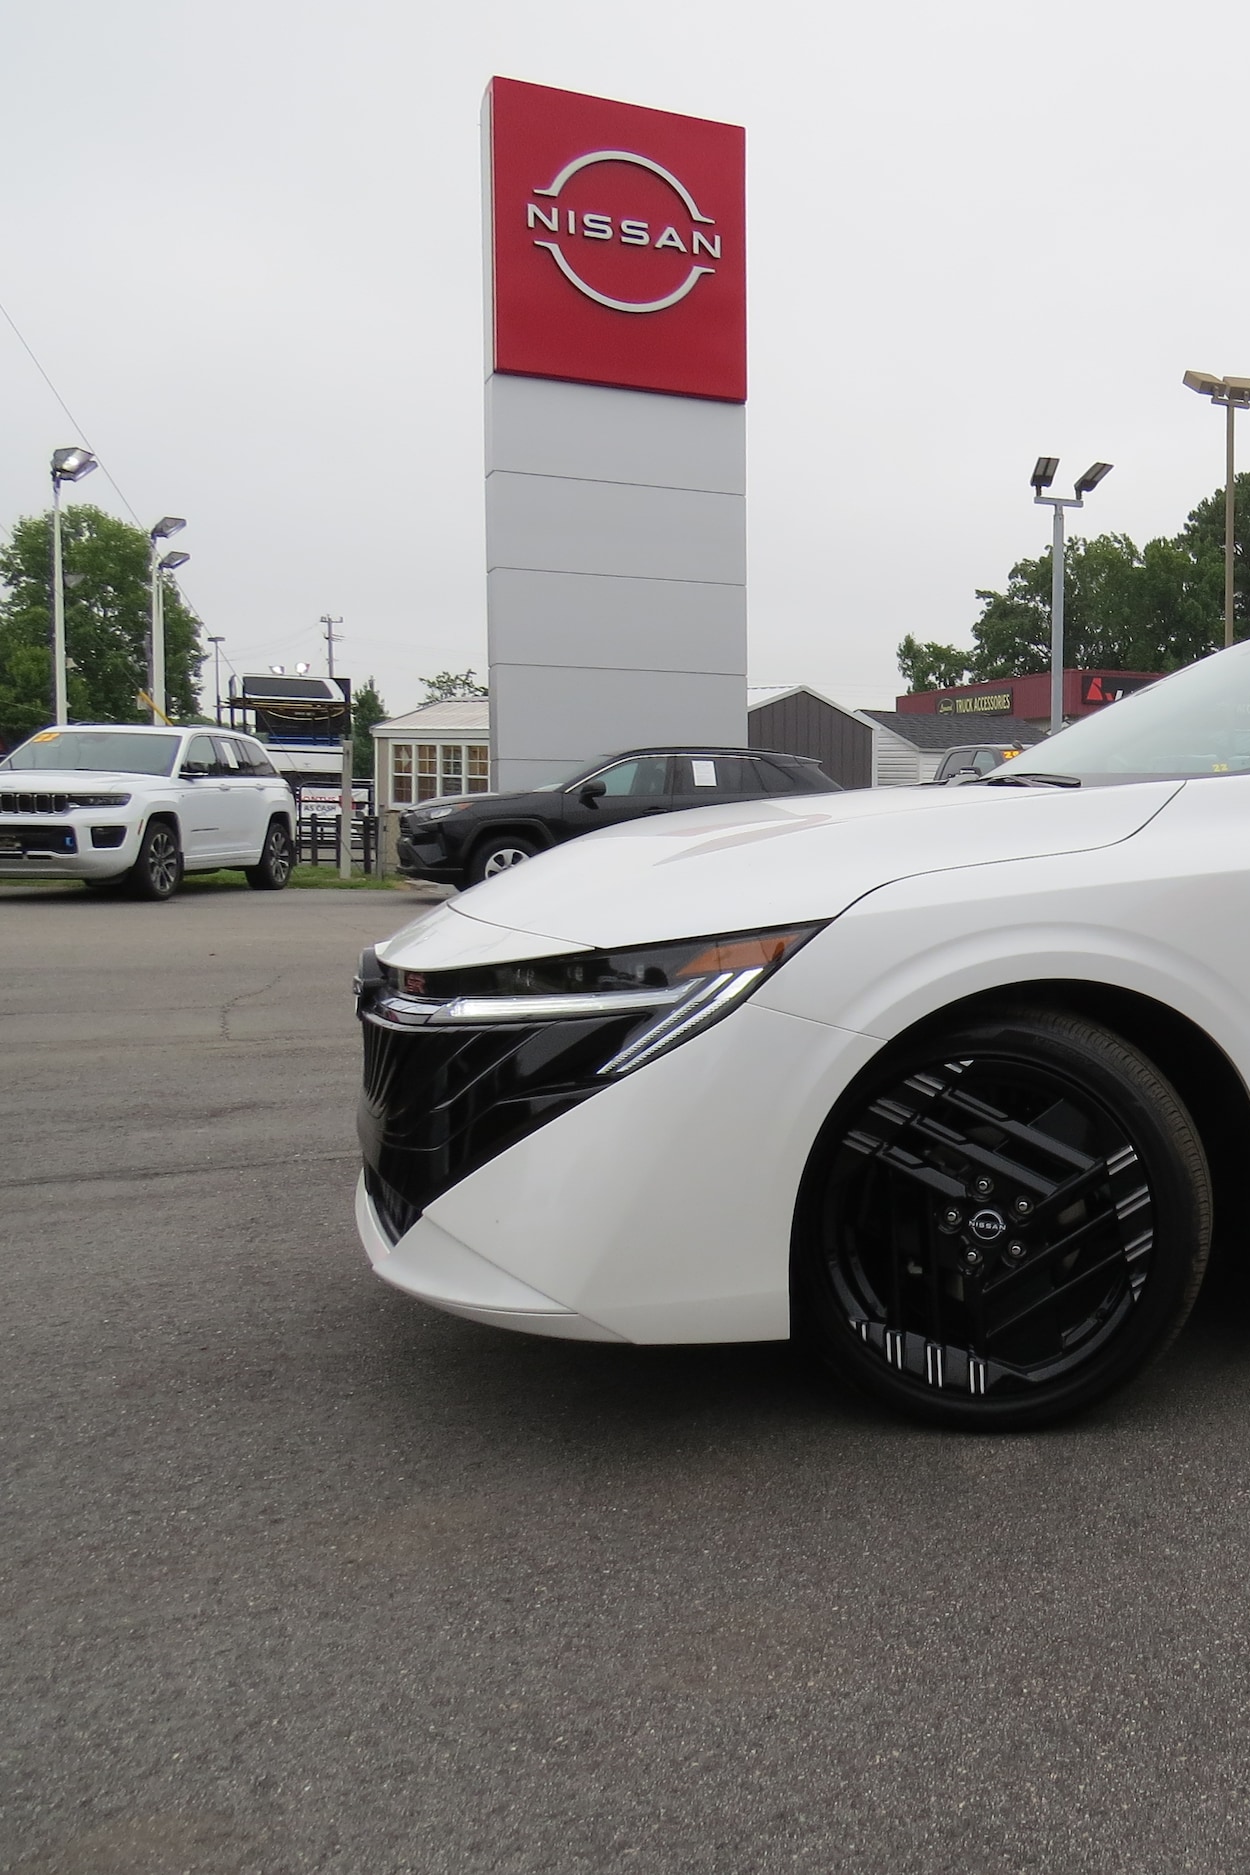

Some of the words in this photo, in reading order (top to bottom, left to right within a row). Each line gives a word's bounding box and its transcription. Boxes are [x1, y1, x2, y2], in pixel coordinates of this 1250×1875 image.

[527, 203, 722, 259] NISSAN
[956, 698, 974, 713] TRUCK
[974, 694, 1011, 712] ACCESSORIES
[316, 804, 336, 812] CASH
[969, 1220, 1006, 1231] NISSAN
